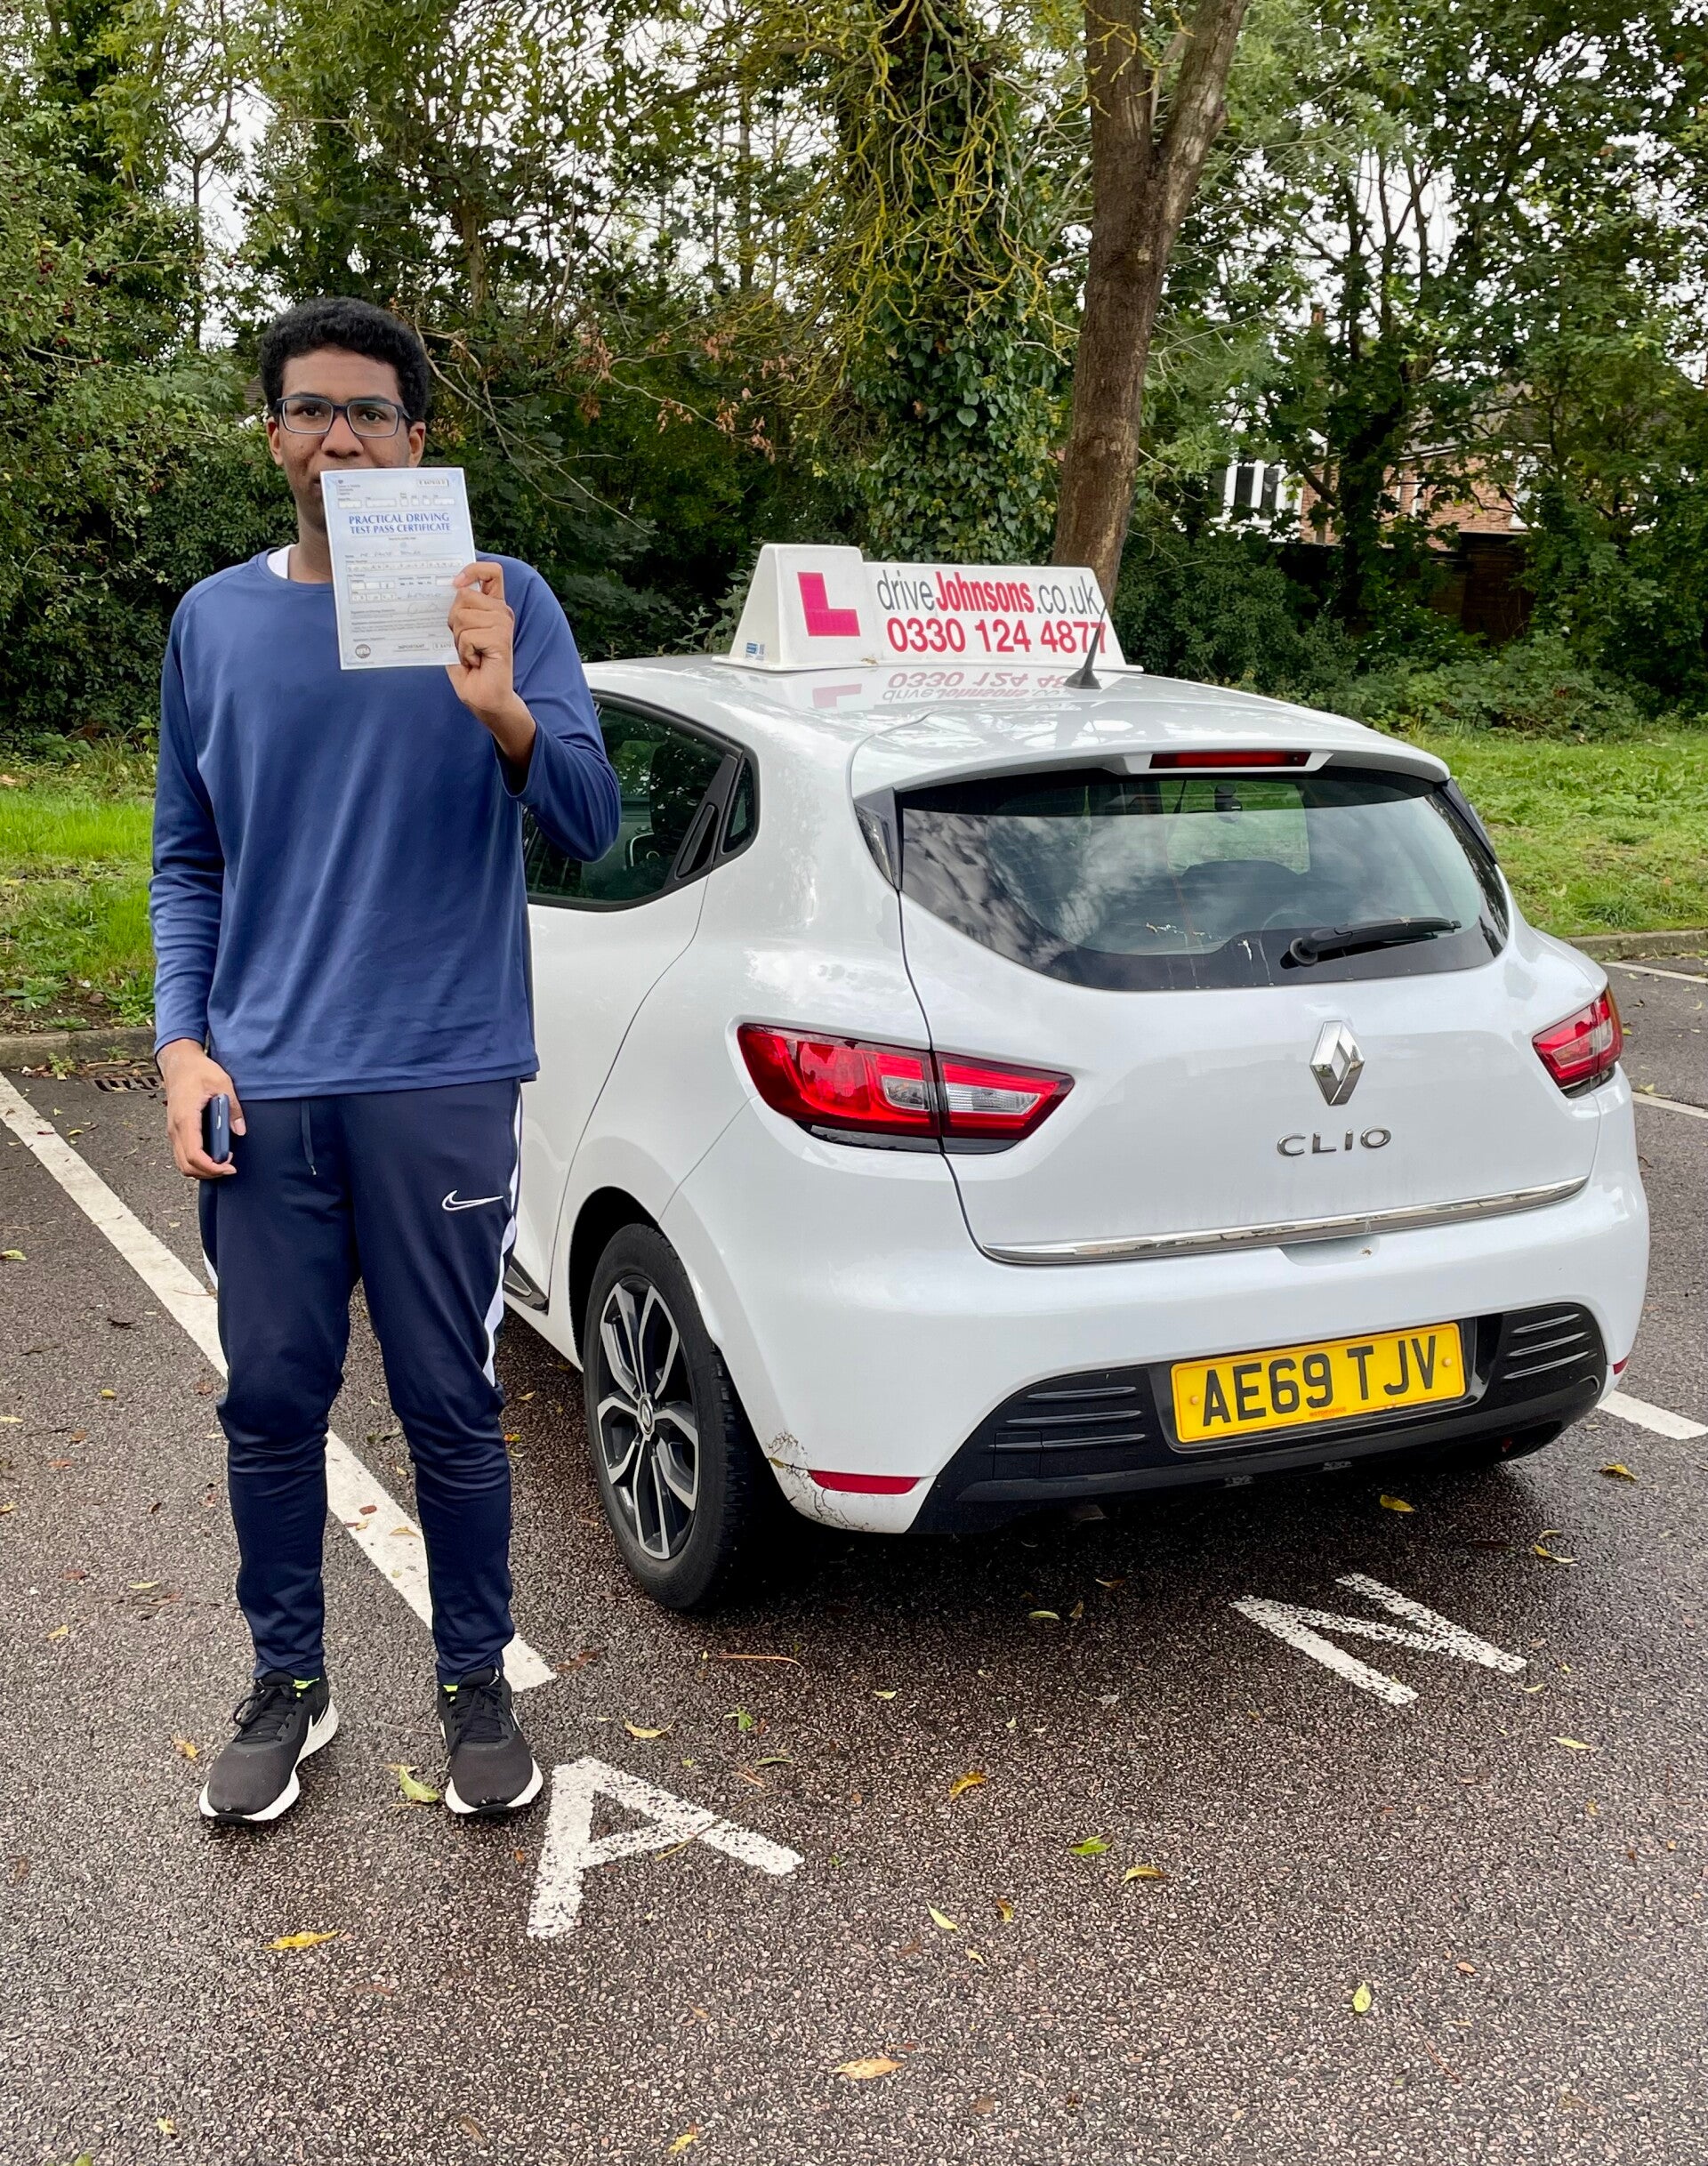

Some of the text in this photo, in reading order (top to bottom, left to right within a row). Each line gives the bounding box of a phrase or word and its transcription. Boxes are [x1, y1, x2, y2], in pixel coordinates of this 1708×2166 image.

[349, 512, 450, 525] PRACTICAL DRIVING
[350, 523, 450, 535] TEST PASS CERTIFICATE
[797, 572, 860, 637] L
[877, 569, 1100, 615] driveJohnsons.co.uk
[887, 617, 1106, 654] 0330 124 4877
[1277, 1126, 1392, 1156] CLIO
[1203, 1336, 1436, 1426] AE69 TJV
[527, 1756, 805, 1939] A
